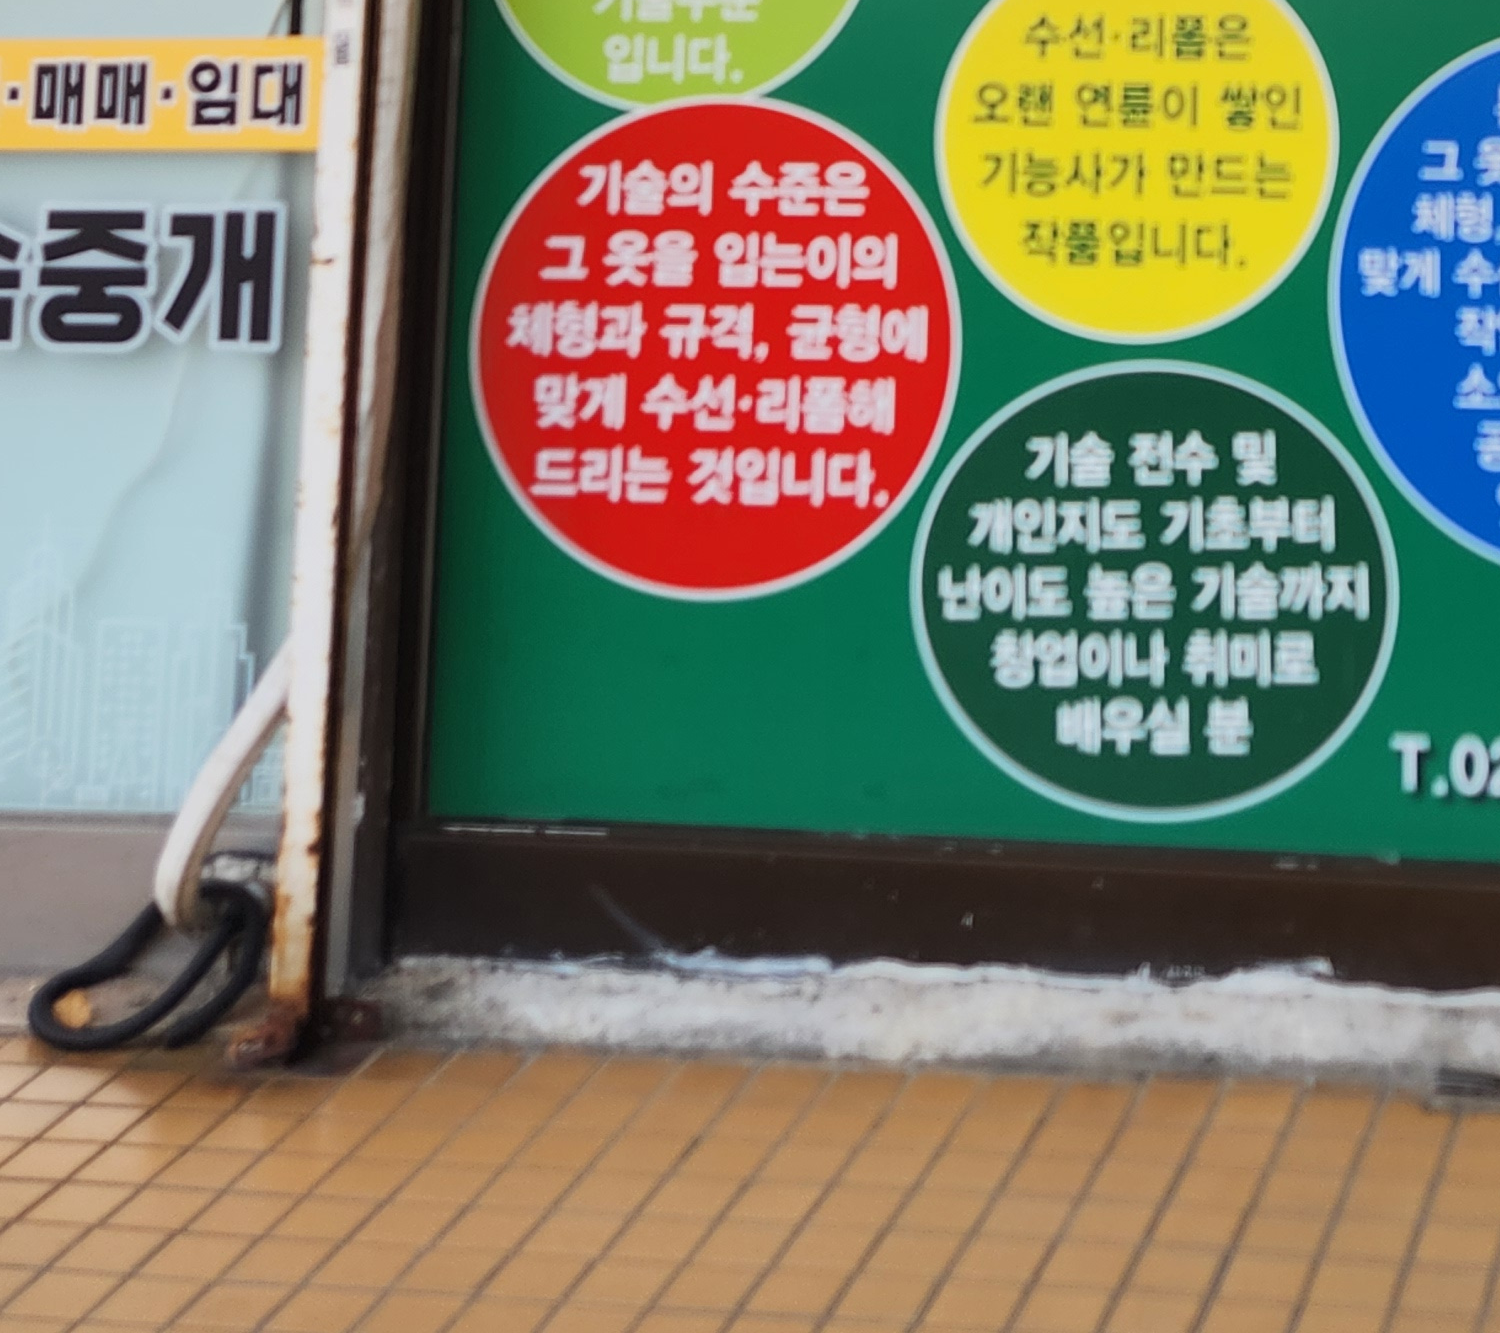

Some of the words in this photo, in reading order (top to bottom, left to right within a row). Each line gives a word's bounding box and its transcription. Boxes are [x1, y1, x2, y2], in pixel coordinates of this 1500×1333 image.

[602, 33, 745, 85] 입니다.
[972, 81, 1056, 129] 오랜
[1076, 81, 1198, 130] 연륜이
[576, 158, 714, 217] 기술의
[727, 160, 871, 218] 수준은
[980, 150, 1147, 199] 기능사가
[1167, 151, 1293, 201] 만드는
[1417, 138, 1464, 184] 그
[538, 235, 590, 282] 그
[602, 229, 699, 288] 옷을
[1022, 219, 1248, 269] 작품입니다.
[1356, 245, 1442, 299] 맞게
[0, 206, 279, 346] 중개
[505, 300, 648, 360] 체형과
[786, 302, 931, 363] 균형에
[532, 372, 628, 431] 맞게
[529, 443, 672, 504] 드리는
[686, 445, 891, 509] 것입니다.
[1024, 429, 1116, 490] 기술
[1126, 429, 1220, 488] 전수
[1231, 427, 1279, 487] 및
[968, 495, 1147, 556] 개인지도
[1158, 495, 1337, 555] 기초부터
[1083, 561, 1177, 622] 높은
[1190, 561, 1372, 622] 기술까지
[989, 627, 1171, 690] 창업이나
[1182, 626, 1321, 690] 취미로
[1054, 694, 1192, 758] 배우실
[1203, 695, 1254, 758] 분
